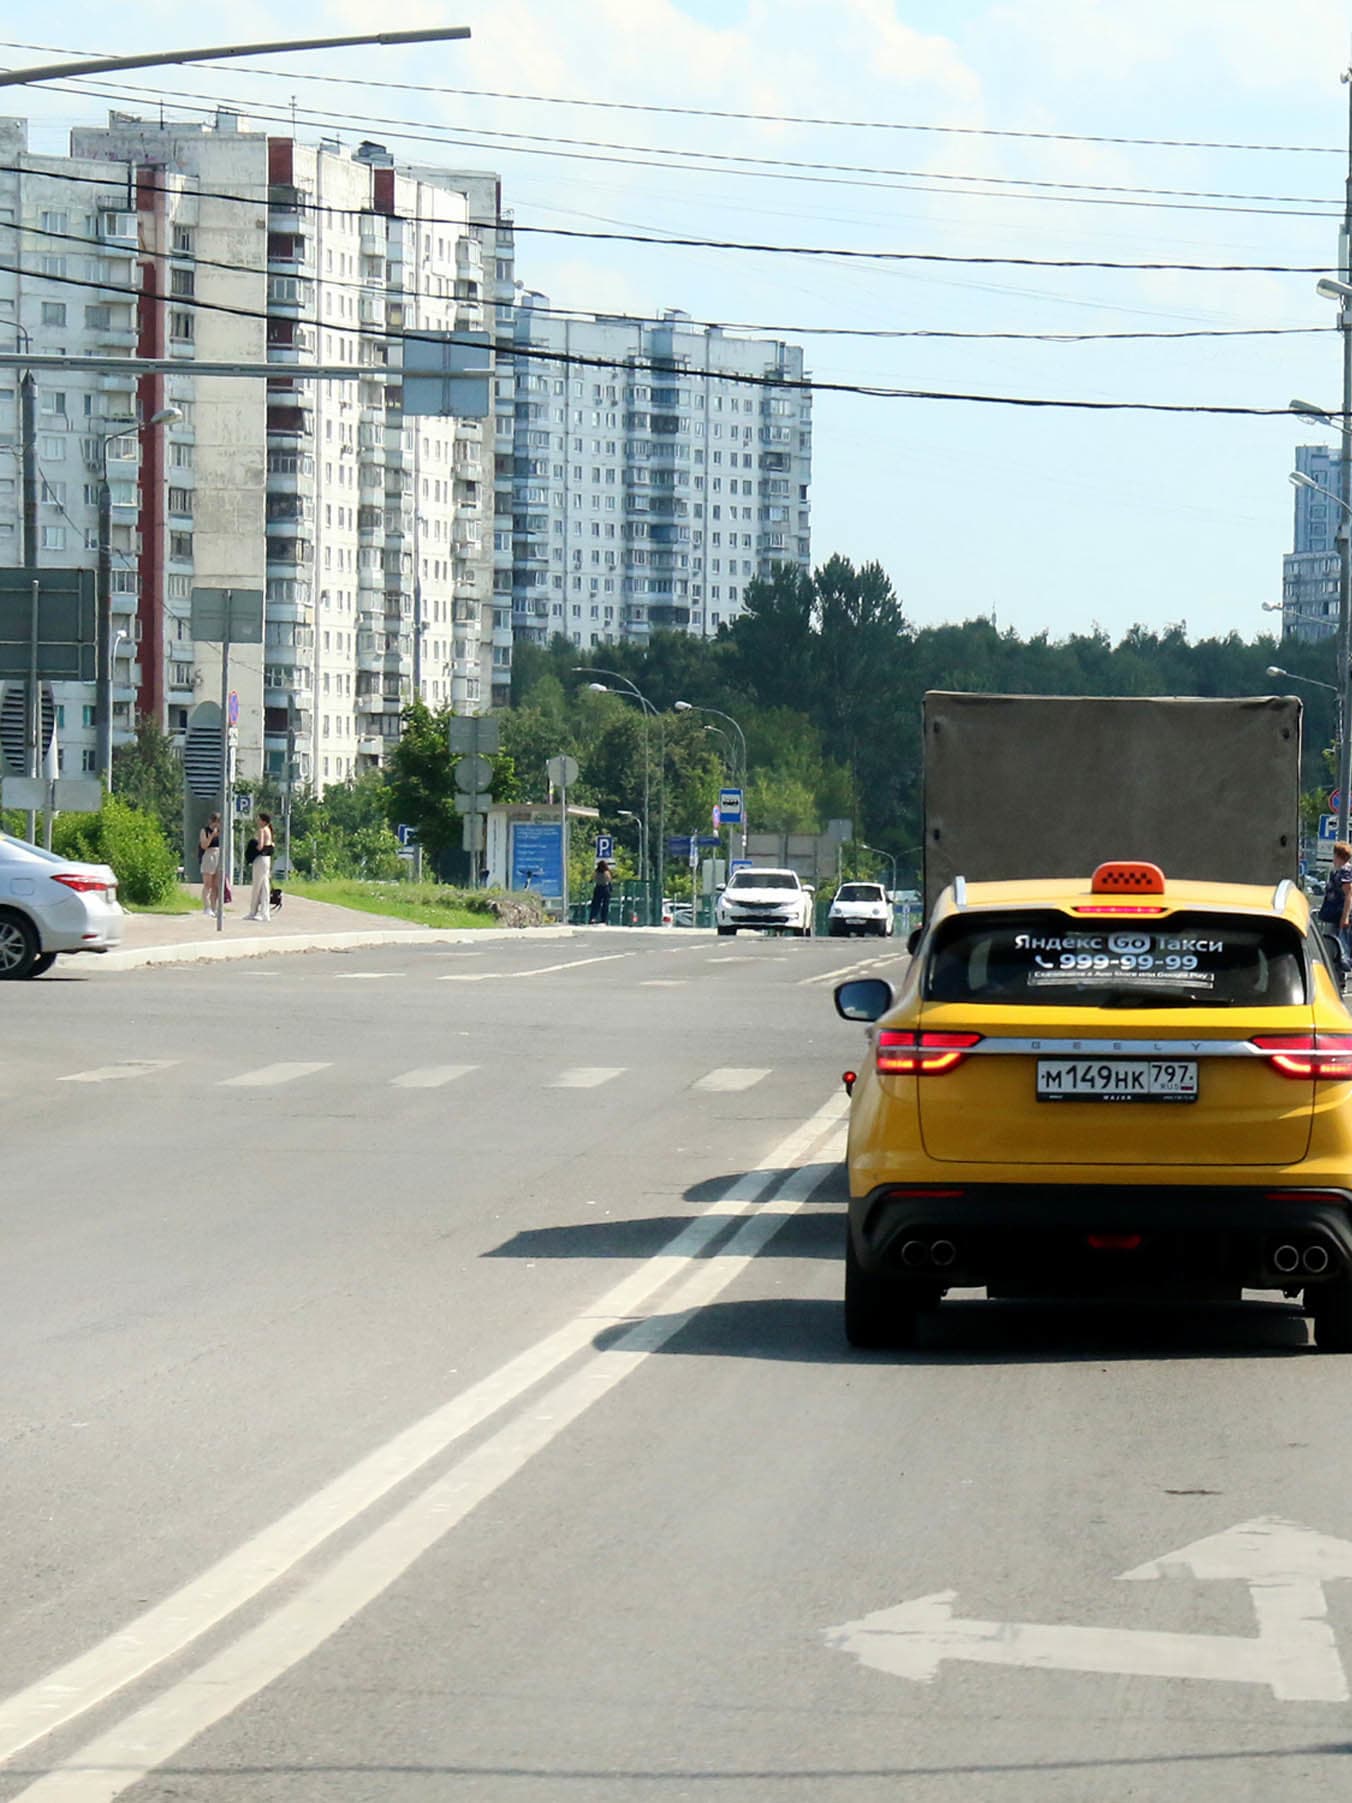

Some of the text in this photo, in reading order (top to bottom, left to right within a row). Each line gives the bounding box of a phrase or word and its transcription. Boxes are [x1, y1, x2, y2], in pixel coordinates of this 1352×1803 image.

[1015, 934, 1103, 950] Яндекс
[1158, 937, 1224, 952] Такси
[1060, 953, 1199, 970] 999-99-99
[1031, 1041, 1201, 1051] GEELY
[1046, 1064, 1188, 1089] М149НК 797
